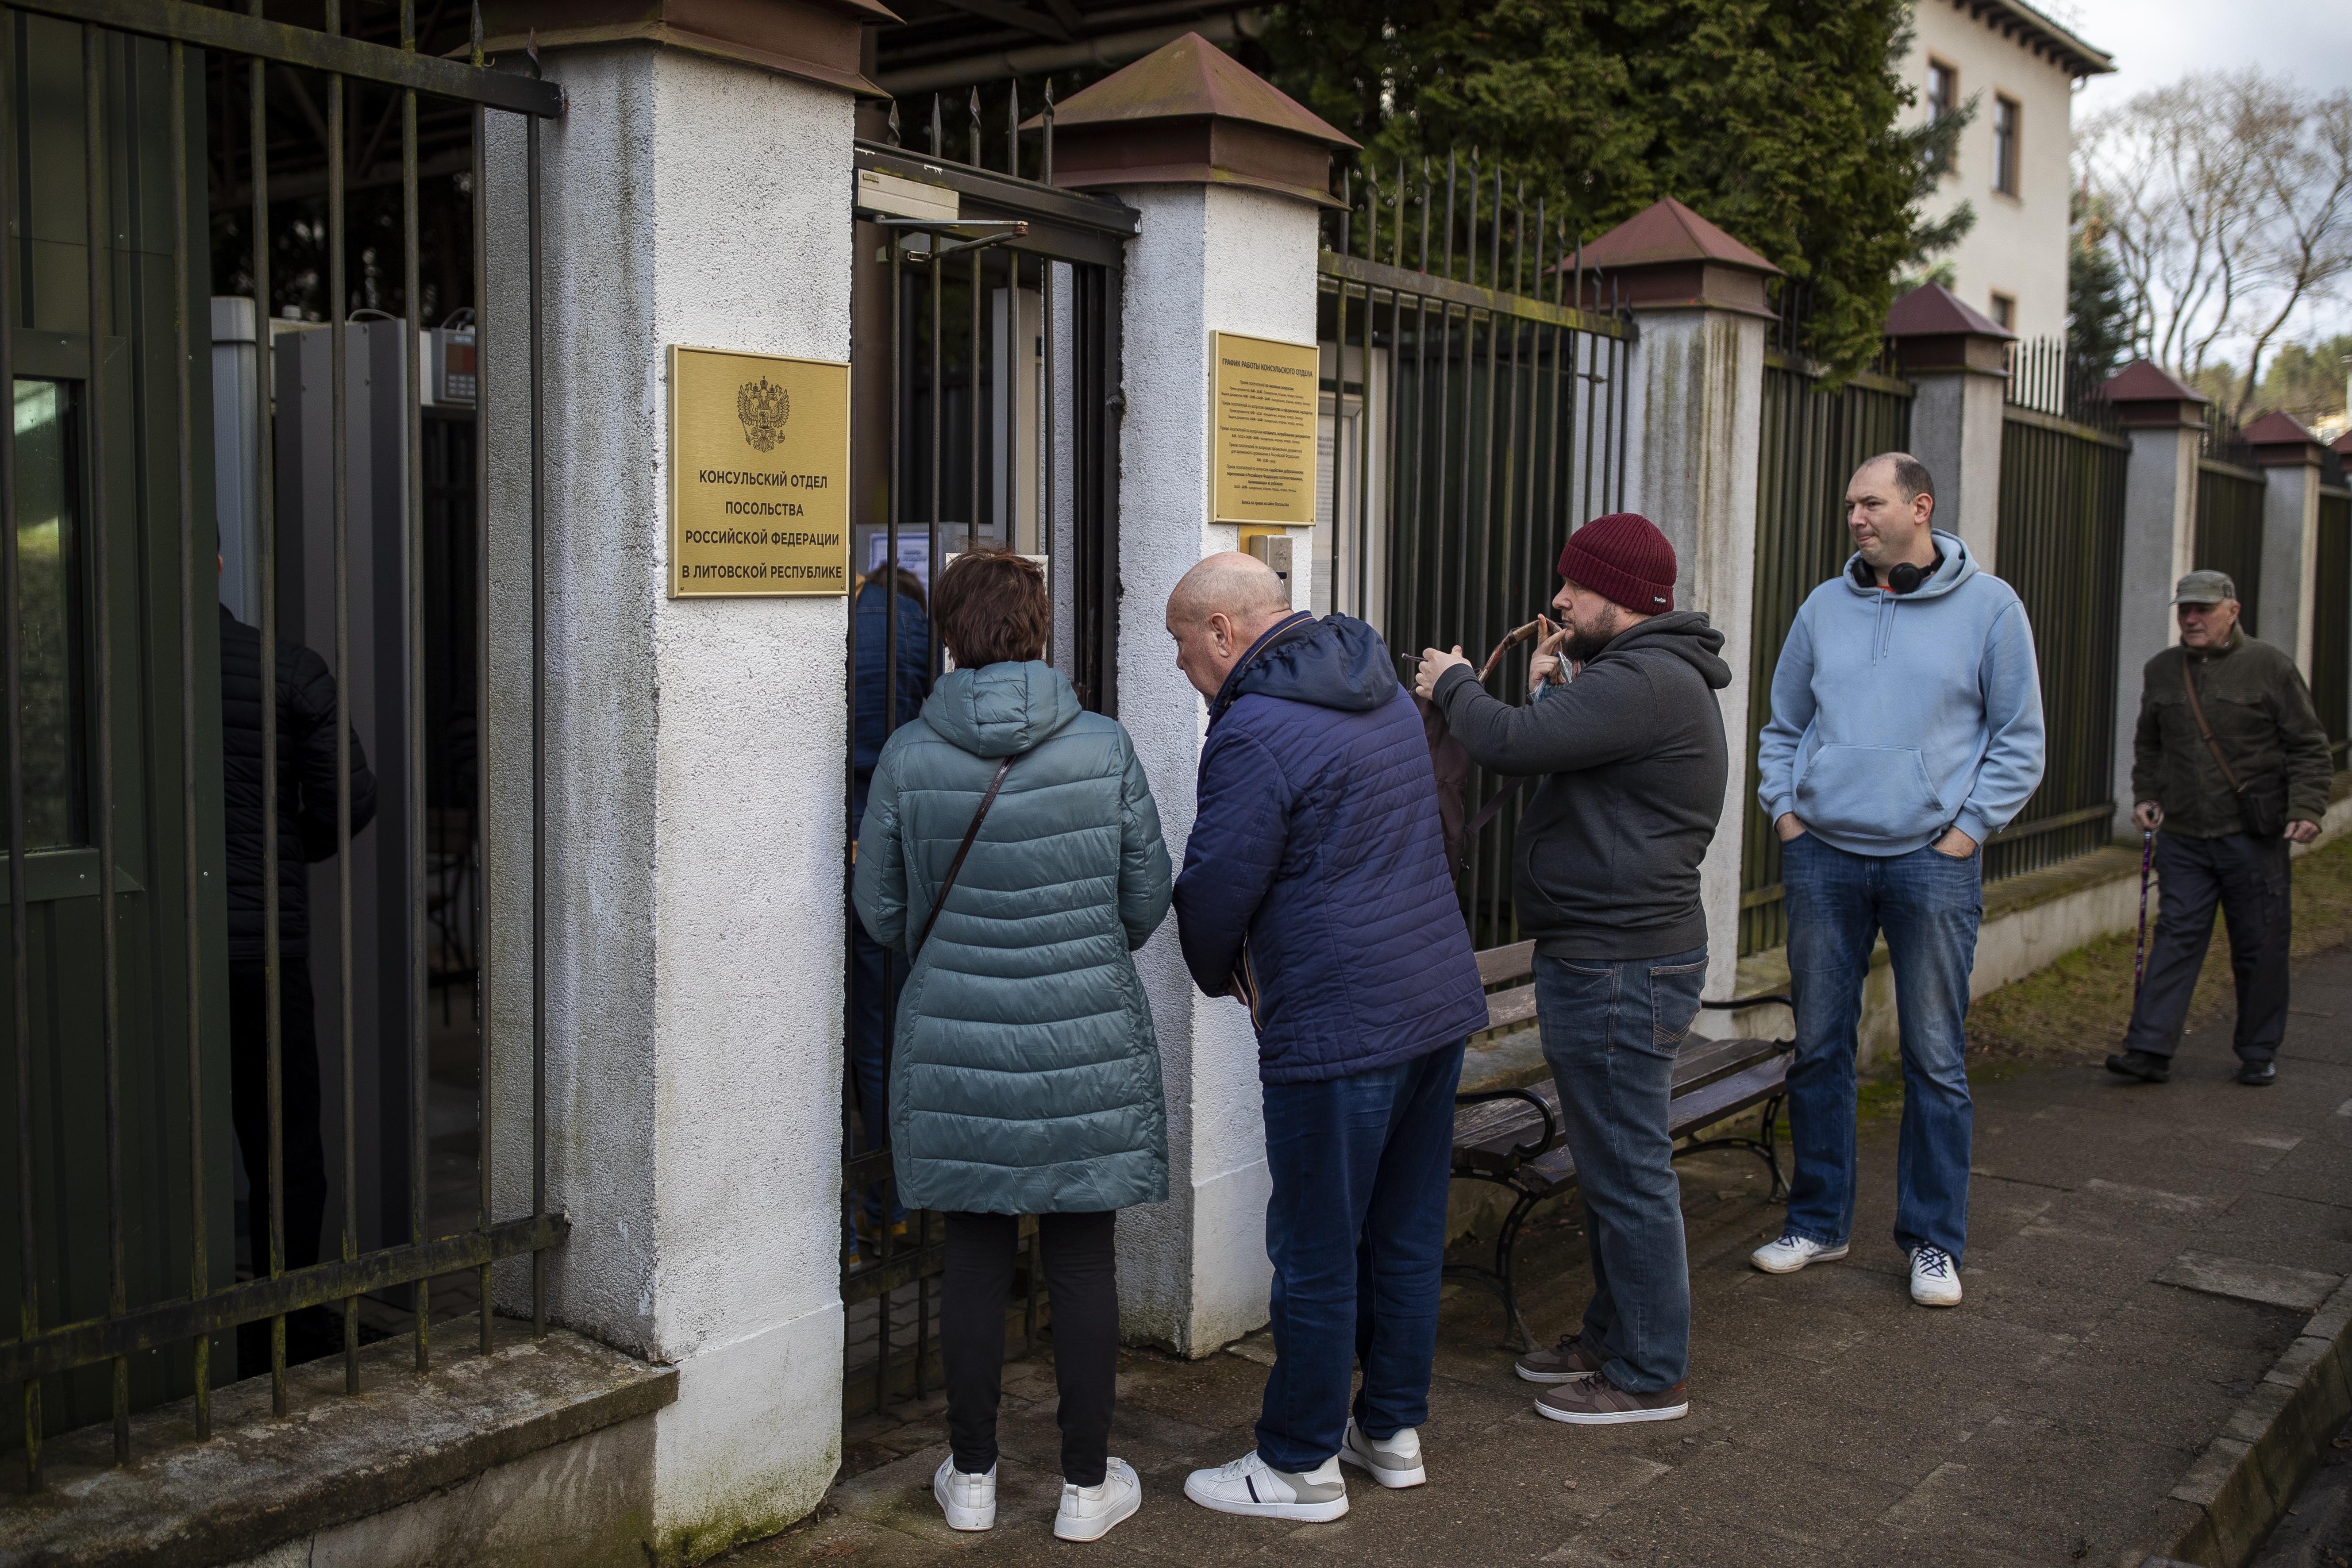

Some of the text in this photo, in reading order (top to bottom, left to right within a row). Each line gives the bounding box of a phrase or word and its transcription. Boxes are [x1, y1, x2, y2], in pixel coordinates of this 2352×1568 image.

[1222, 358, 1313, 378] ГРАФИК РАБОТЫ КОНСУЛЬСКОГО ОТДЕЛА
[699, 469, 828, 489] КОНСУЛЬСКИЙ ОТДЕЛ
[725, 501, 804, 516] ПОСОЛЬСТВА
[685, 528, 839, 547] РОССИЙСКОЙ ФЕДЕРАЦИИ
[681, 562, 842, 579] В ЛИТОВСКОЙ РЕСПУБЛИКЕ
